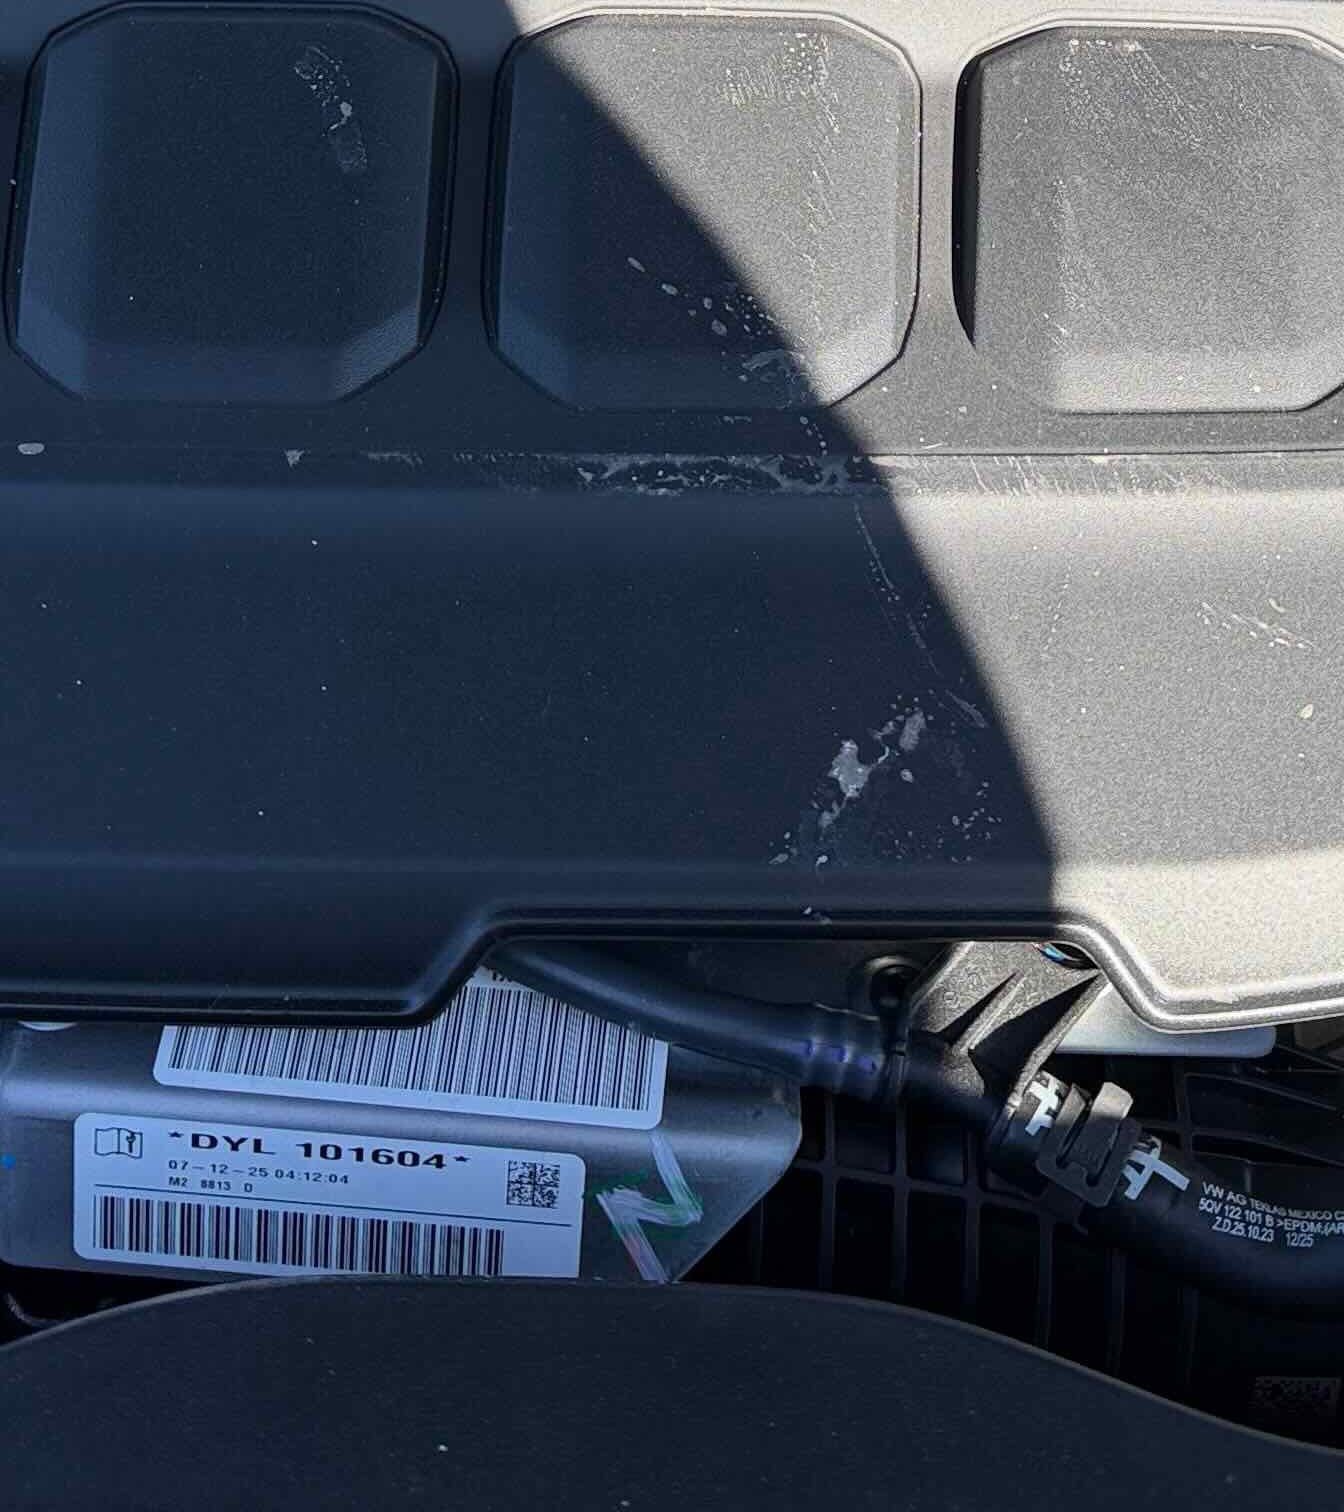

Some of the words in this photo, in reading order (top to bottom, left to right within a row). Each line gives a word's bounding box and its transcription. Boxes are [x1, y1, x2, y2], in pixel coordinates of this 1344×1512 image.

[1202, 1181, 1224, 1199] VW
[1226, 1191, 1247, 1206] AG
[1199, 1197, 1223, 1214] 5QV
[1224, 1204, 1242, 1220] 122
[1244, 1209, 1262, 1225] 101
